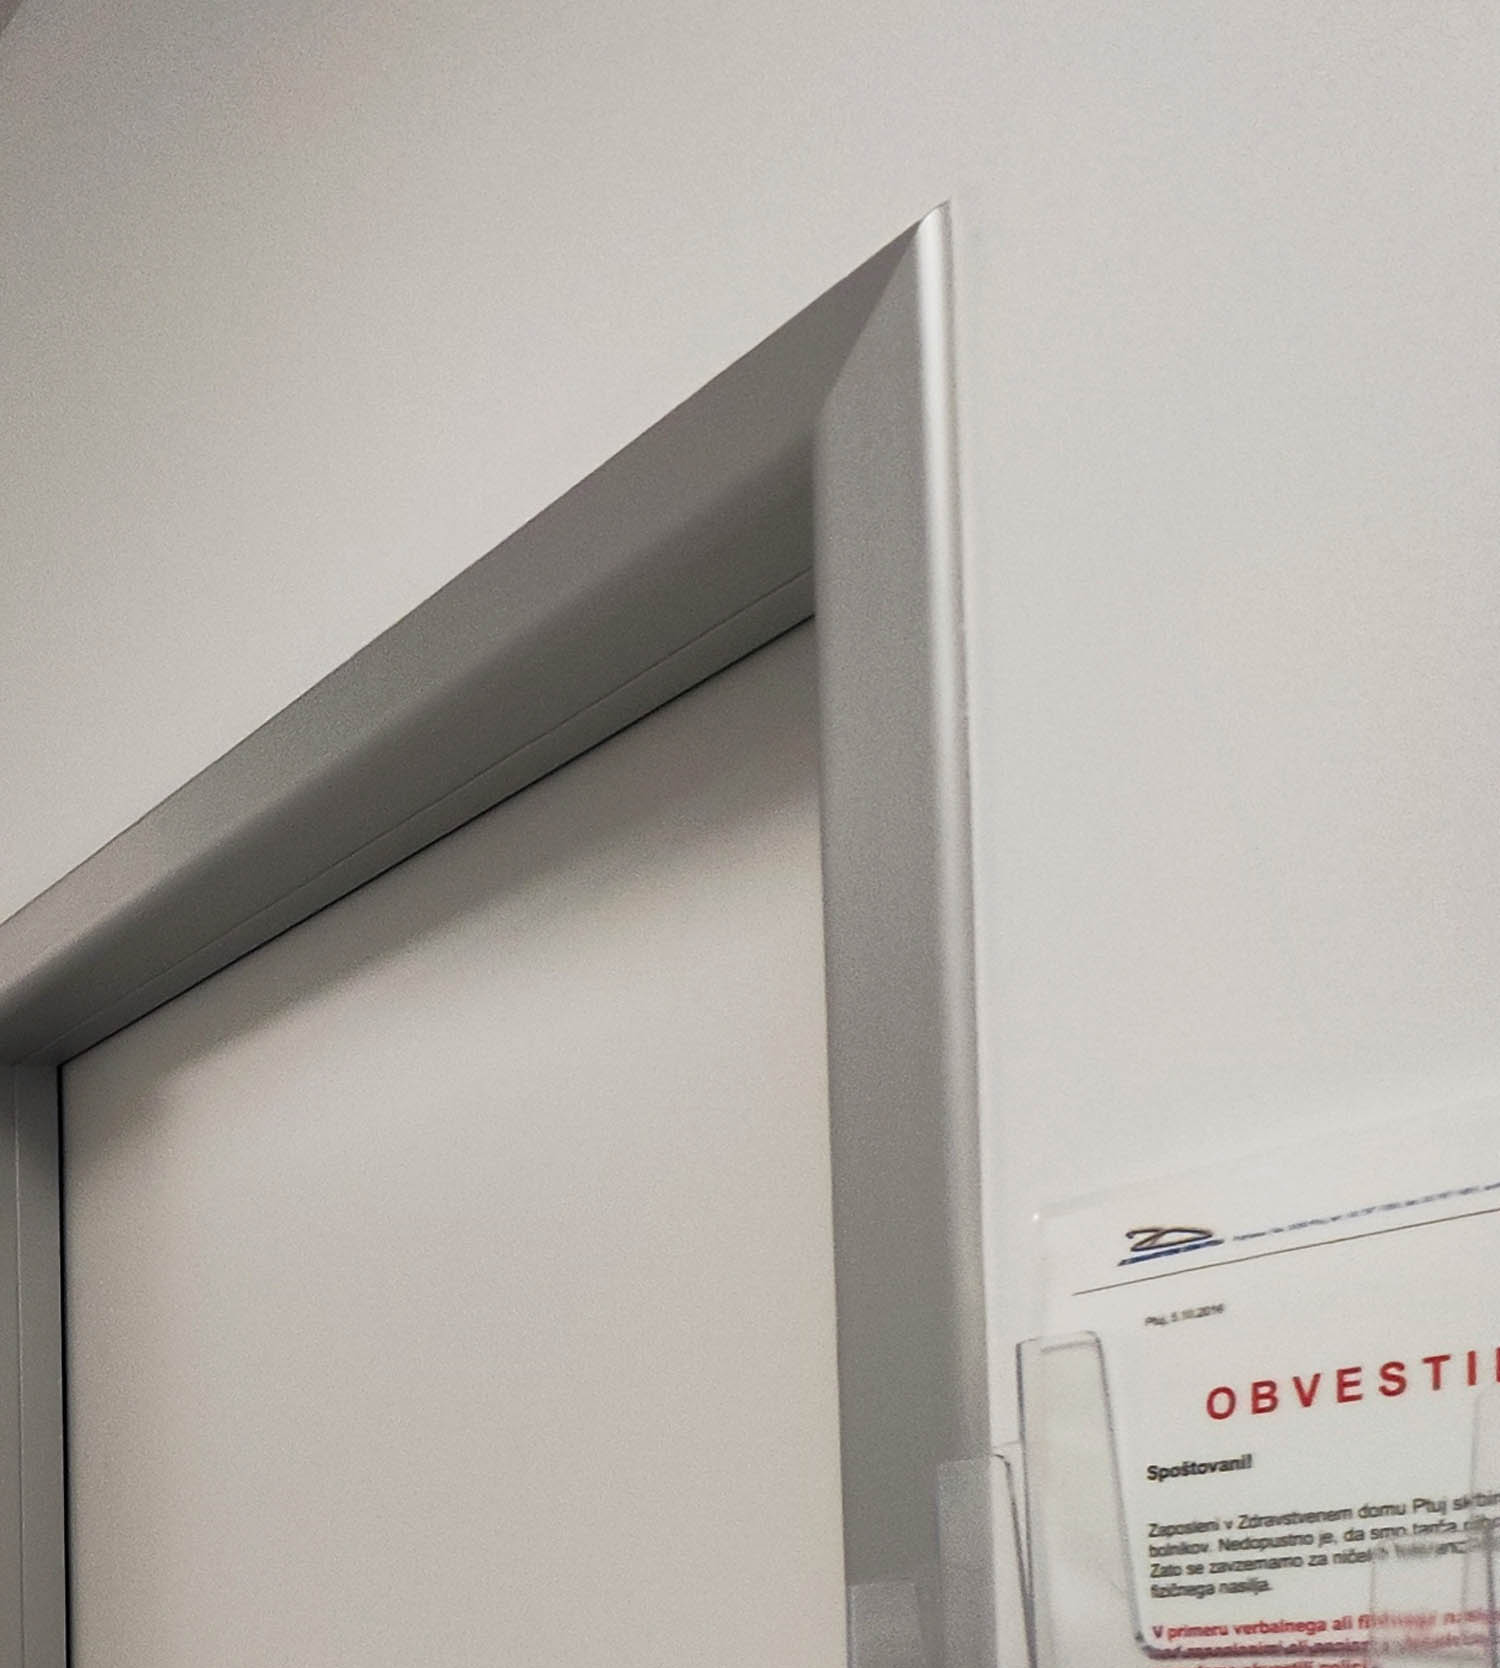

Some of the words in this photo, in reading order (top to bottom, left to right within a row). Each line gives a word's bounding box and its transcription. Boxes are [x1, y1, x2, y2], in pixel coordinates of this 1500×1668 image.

[1146, 1453, 1253, 1482] Spoštovani!
[1148, 1520, 1220, 1538] Zaposleni
[1237, 1507, 1353, 1530] Zdravstvenem
[1358, 1503, 1406, 1520] domu
[1412, 1497, 1447, 1516] Ptuj
[1218, 1533, 1314, 1553] Nedopustno
[1343, 1526, 1365, 1542] da
[1150, 1563, 1183, 1578] Zato
[1185, 1563, 1205, 1575] se
[1208, 1556, 1304, 1574] zavzemamo
[1308, 1553, 1328, 1567] za
[1168, 1625, 1229, 1642] primeru
[1233, 1619, 1327, 1637] verbalnega
[1332, 1615, 1353, 1631] ali
